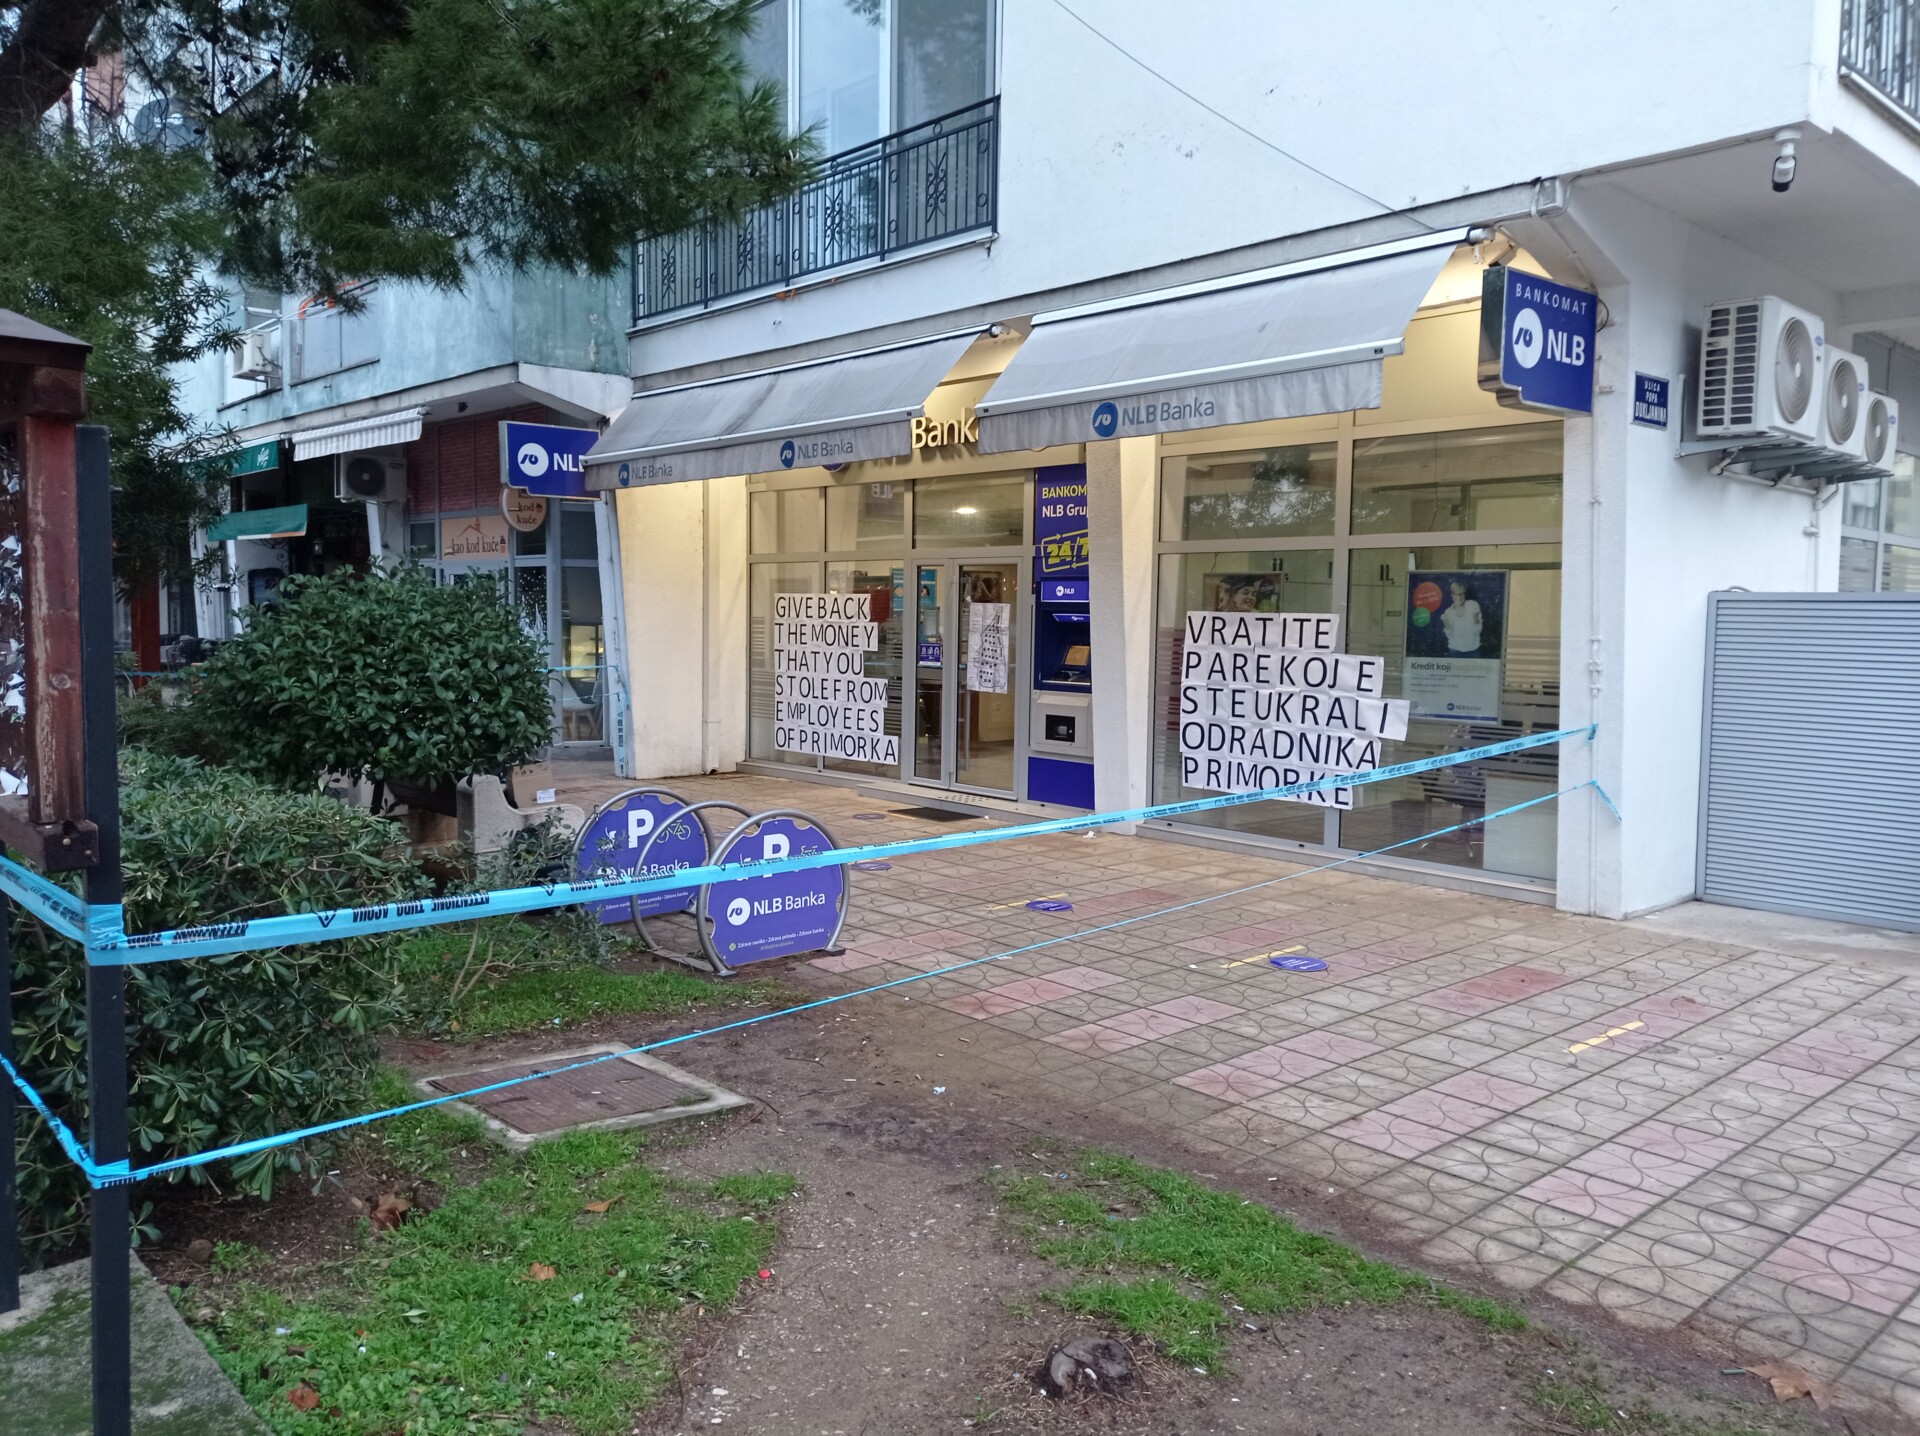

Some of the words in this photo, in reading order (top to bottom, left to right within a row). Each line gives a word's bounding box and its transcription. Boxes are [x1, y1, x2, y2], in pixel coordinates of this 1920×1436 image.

[1516, 283, 1587, 315] BANKOMAT
[1547, 329, 1585, 366] NLB
[1122, 404, 1157, 426] NLB
[1159, 397, 1214, 420] Banka
[911, 407, 979, 449] Bank
[798, 444, 819, 459] NLB
[821, 439, 853, 457] Banka
[631, 467, 648, 480] NLB
[648, 464, 672, 478] Banka
[517, 514, 537, 524] kuće
[518, 502, 535, 512] kod
[1042, 504, 1064, 518] NLB
[451, 538, 464, 553] kao
[466, 537, 480, 553] kod
[481, 536, 499, 553] kuće
[1187, 615, 1332, 649] VRATITE
[1411, 662, 1435, 671] Kredit
[1436, 662, 1451, 672] koji
[776, 701, 880, 733] EMPLOYEES
[627, 808, 655, 849] P
[763, 833, 790, 878] P
[753, 897, 782, 917] NLB
[785, 891, 826, 911] Banka
